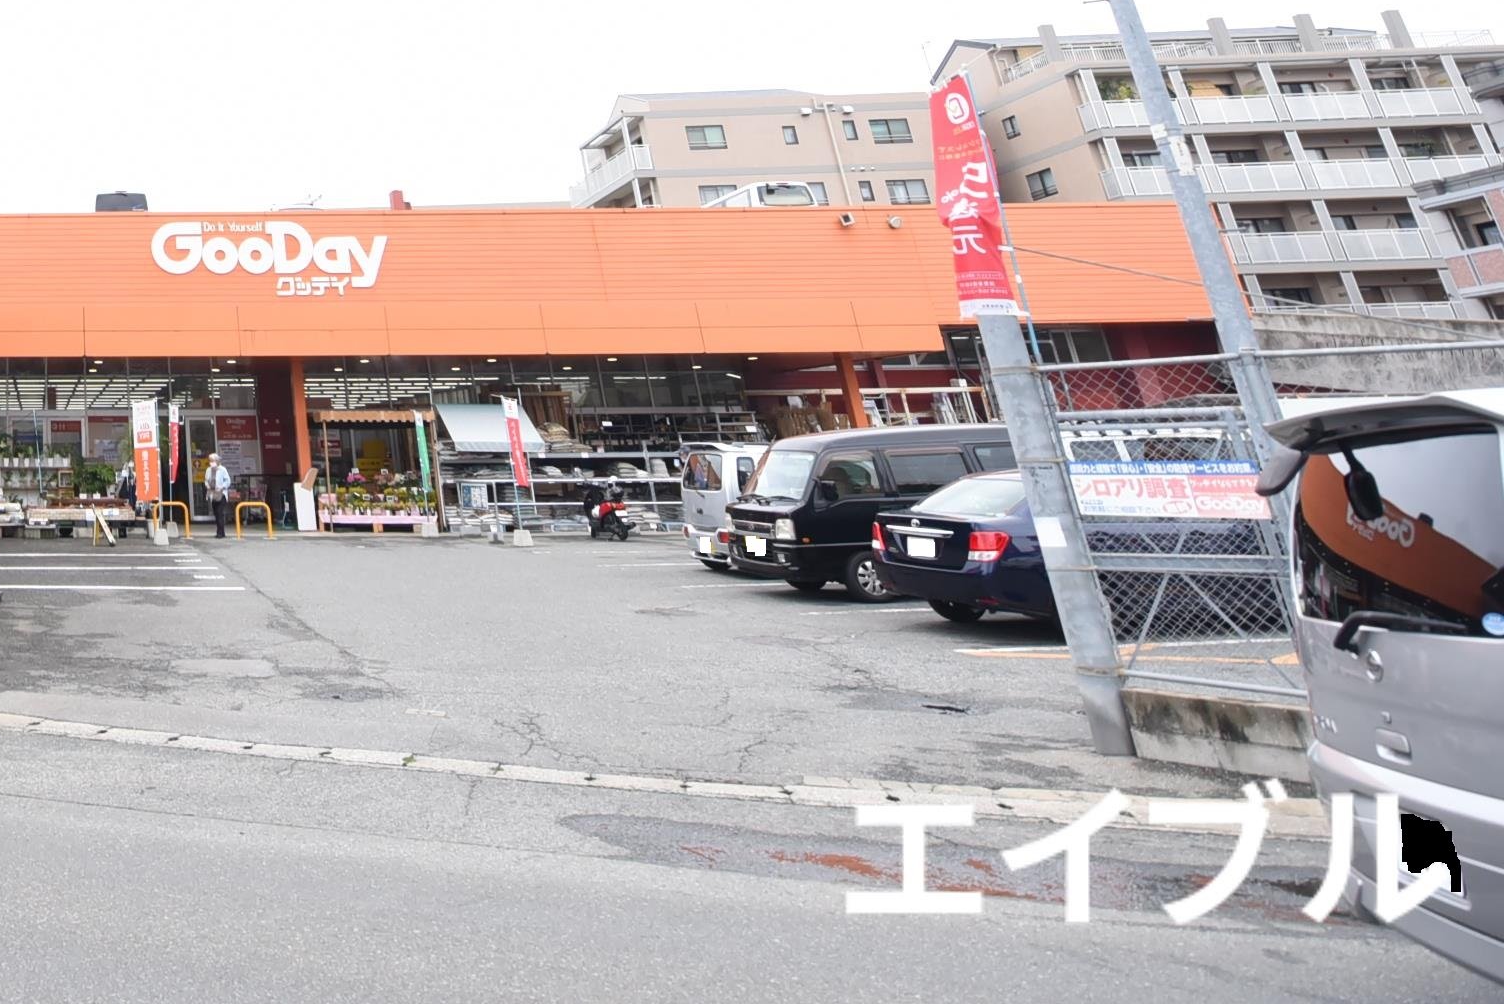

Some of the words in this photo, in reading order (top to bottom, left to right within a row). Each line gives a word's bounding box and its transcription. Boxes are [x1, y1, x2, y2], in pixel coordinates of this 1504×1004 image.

[227, 221, 263, 232] Yourself
[151, 221, 388, 288] GooDay
[276, 277, 351, 297] グッデイ
